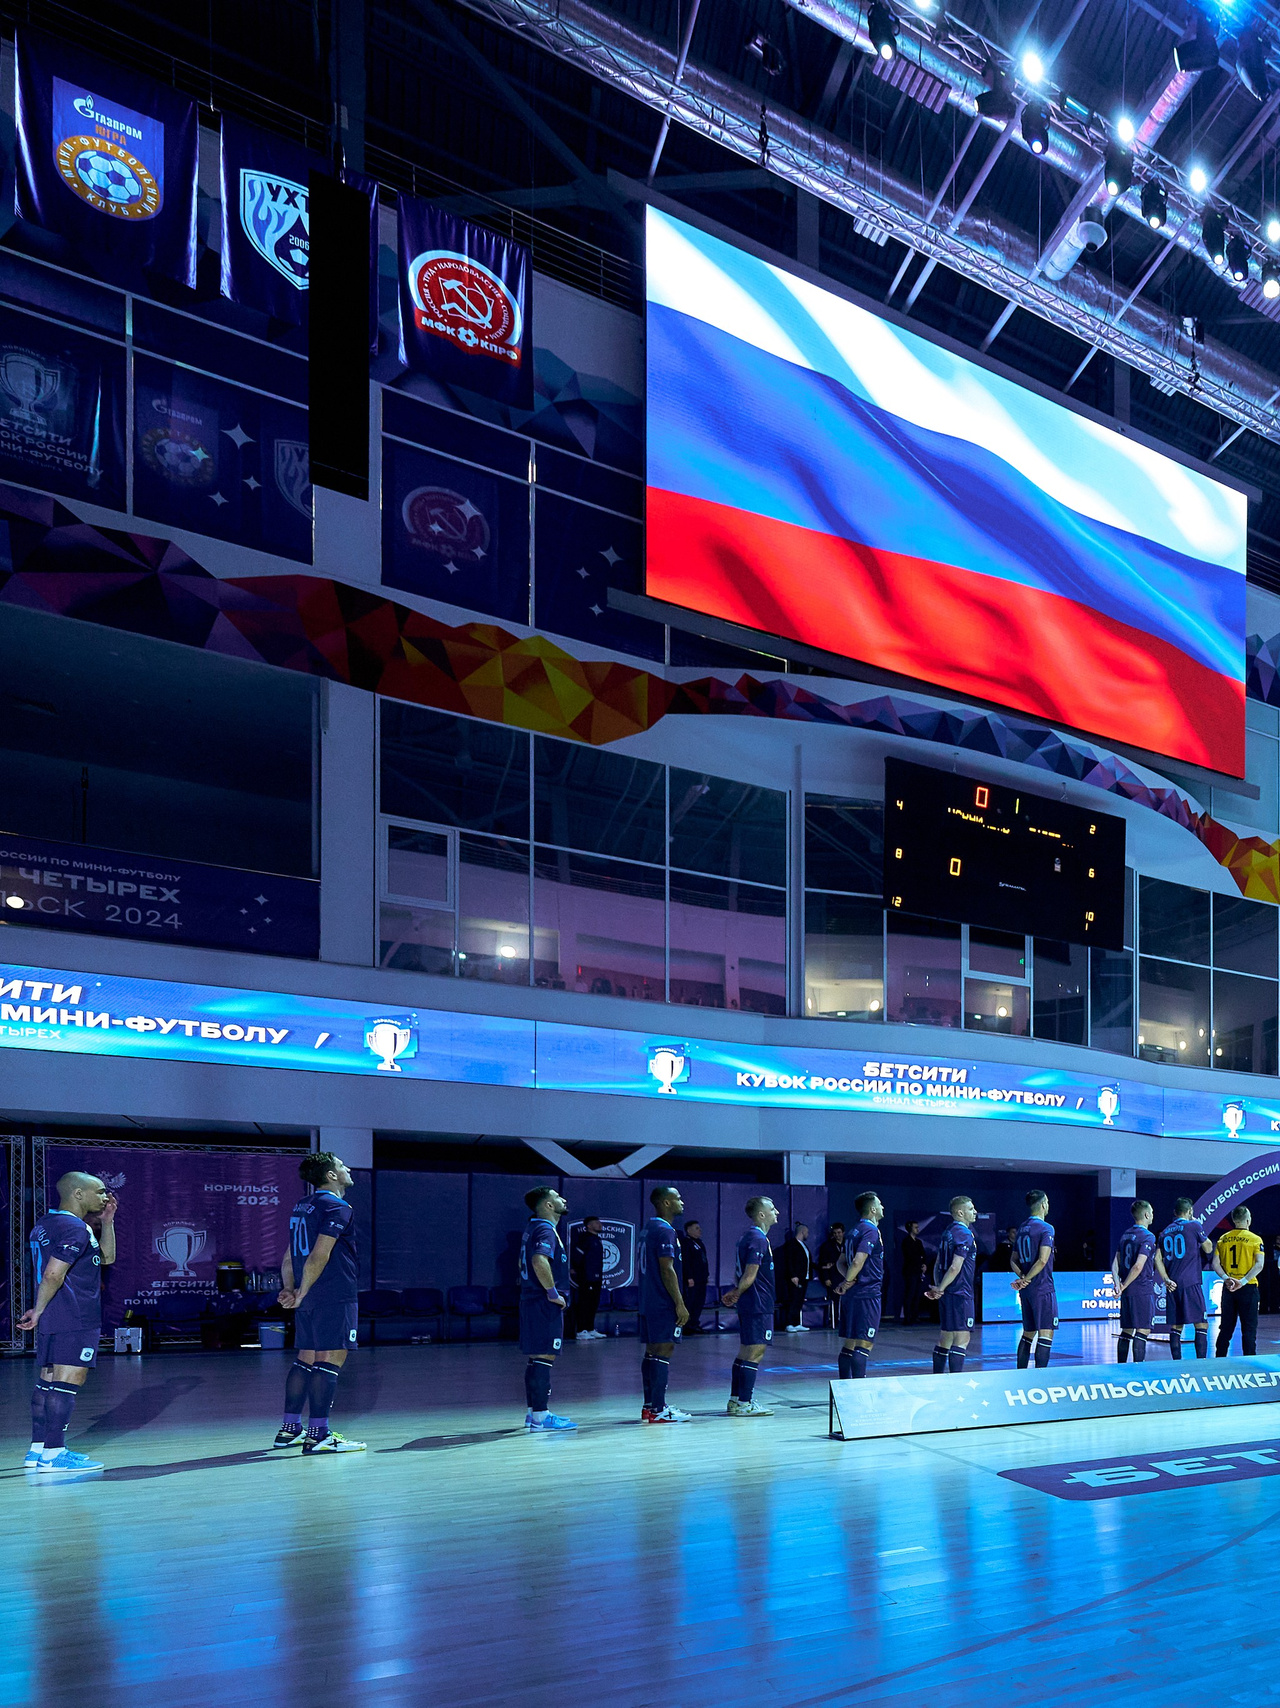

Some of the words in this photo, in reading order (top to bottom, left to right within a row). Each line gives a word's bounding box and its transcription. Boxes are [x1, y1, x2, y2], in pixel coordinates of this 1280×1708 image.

[94, 111, 143, 141] ГАЗПРОМ
[86, 192, 130, 216] КЛУБ
[421, 316, 457, 338] МФК
[480, 339, 518, 361] КПРФ
[25, 437, 88, 462] РОССИИ
[896, 800, 904, 811] 4
[975, 786, 989, 809] 0
[1088, 824, 1097, 836] 2
[895, 847, 903, 859] 8
[50, 857, 70, 867] ПО
[72, 861, 182, 882] МИНИ-ФУТБОЛУ
[949, 857, 962, 877] 0
[1087, 867, 1096, 879] 6
[18, 866, 182, 905] ЧЕТЫРЕХ
[892, 896, 903, 908] 12
[105, 904, 183, 930] 2024
[1085, 911, 1095, 922] 10
[1, 1003, 291, 1045] МИНИ-ФУТБОЛУ
[862, 1061, 967, 1084] БЕТСИТИ
[736, 1072, 807, 1090] КУБОК
[810, 1076, 892, 1094] РОССИИ
[896, 1081, 923, 1096] ПО
[926, 1085, 1066, 1108] МИНИ-ФУТБОЛУ
[872, 1095, 910, 1106] ФИНАЛ
[911, 1098, 958, 1109] ЧЕТЫРЕХ
[204, 1183, 280, 1194] НОРИЛЬСК
[1205, 1183, 1240, 1216] КУБОК
[1238, 1162, 1280, 1189] РОССИИ
[237, 1195, 281, 1206] 2024
[289, 1216, 310, 1257] 70
[1163, 1233, 1186, 1261] 90
[1016, 1233, 1032, 1265] 10
[1229, 1244, 1239, 1269] 1
[150, 1280, 217, 1289] БЕТСИТИ
[124, 1298, 141, 1306] ПО
[1082, 1300, 1097, 1309] ПО
[1004, 1373, 1201, 1407] НОРИЛЬСКИЙ
